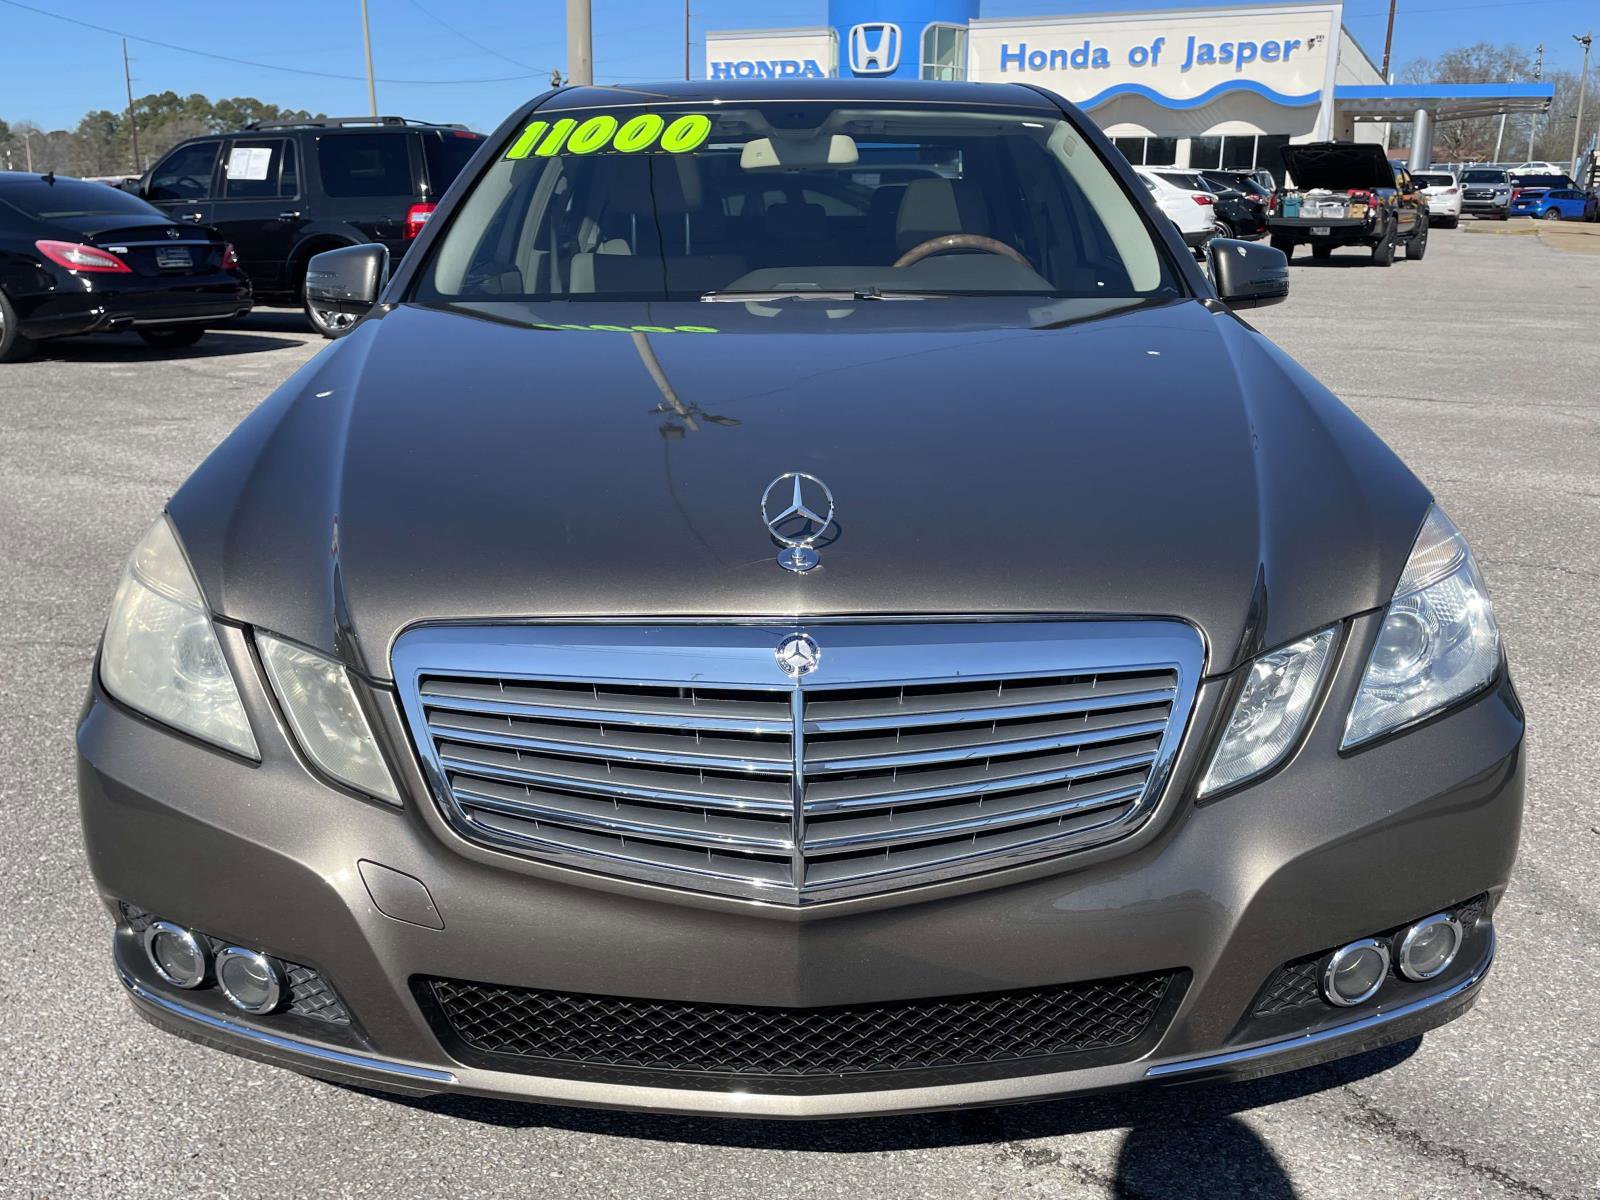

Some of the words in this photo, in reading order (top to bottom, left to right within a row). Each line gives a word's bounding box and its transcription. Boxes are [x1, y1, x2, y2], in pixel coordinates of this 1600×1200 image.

[710, 59, 826, 80] HONDA
[1000, 40, 1110, 72] Honda
[1128, 36, 1165, 68] of
[1180, 35, 1301, 72] Jasper
[505, 113, 713, 160] 11000
